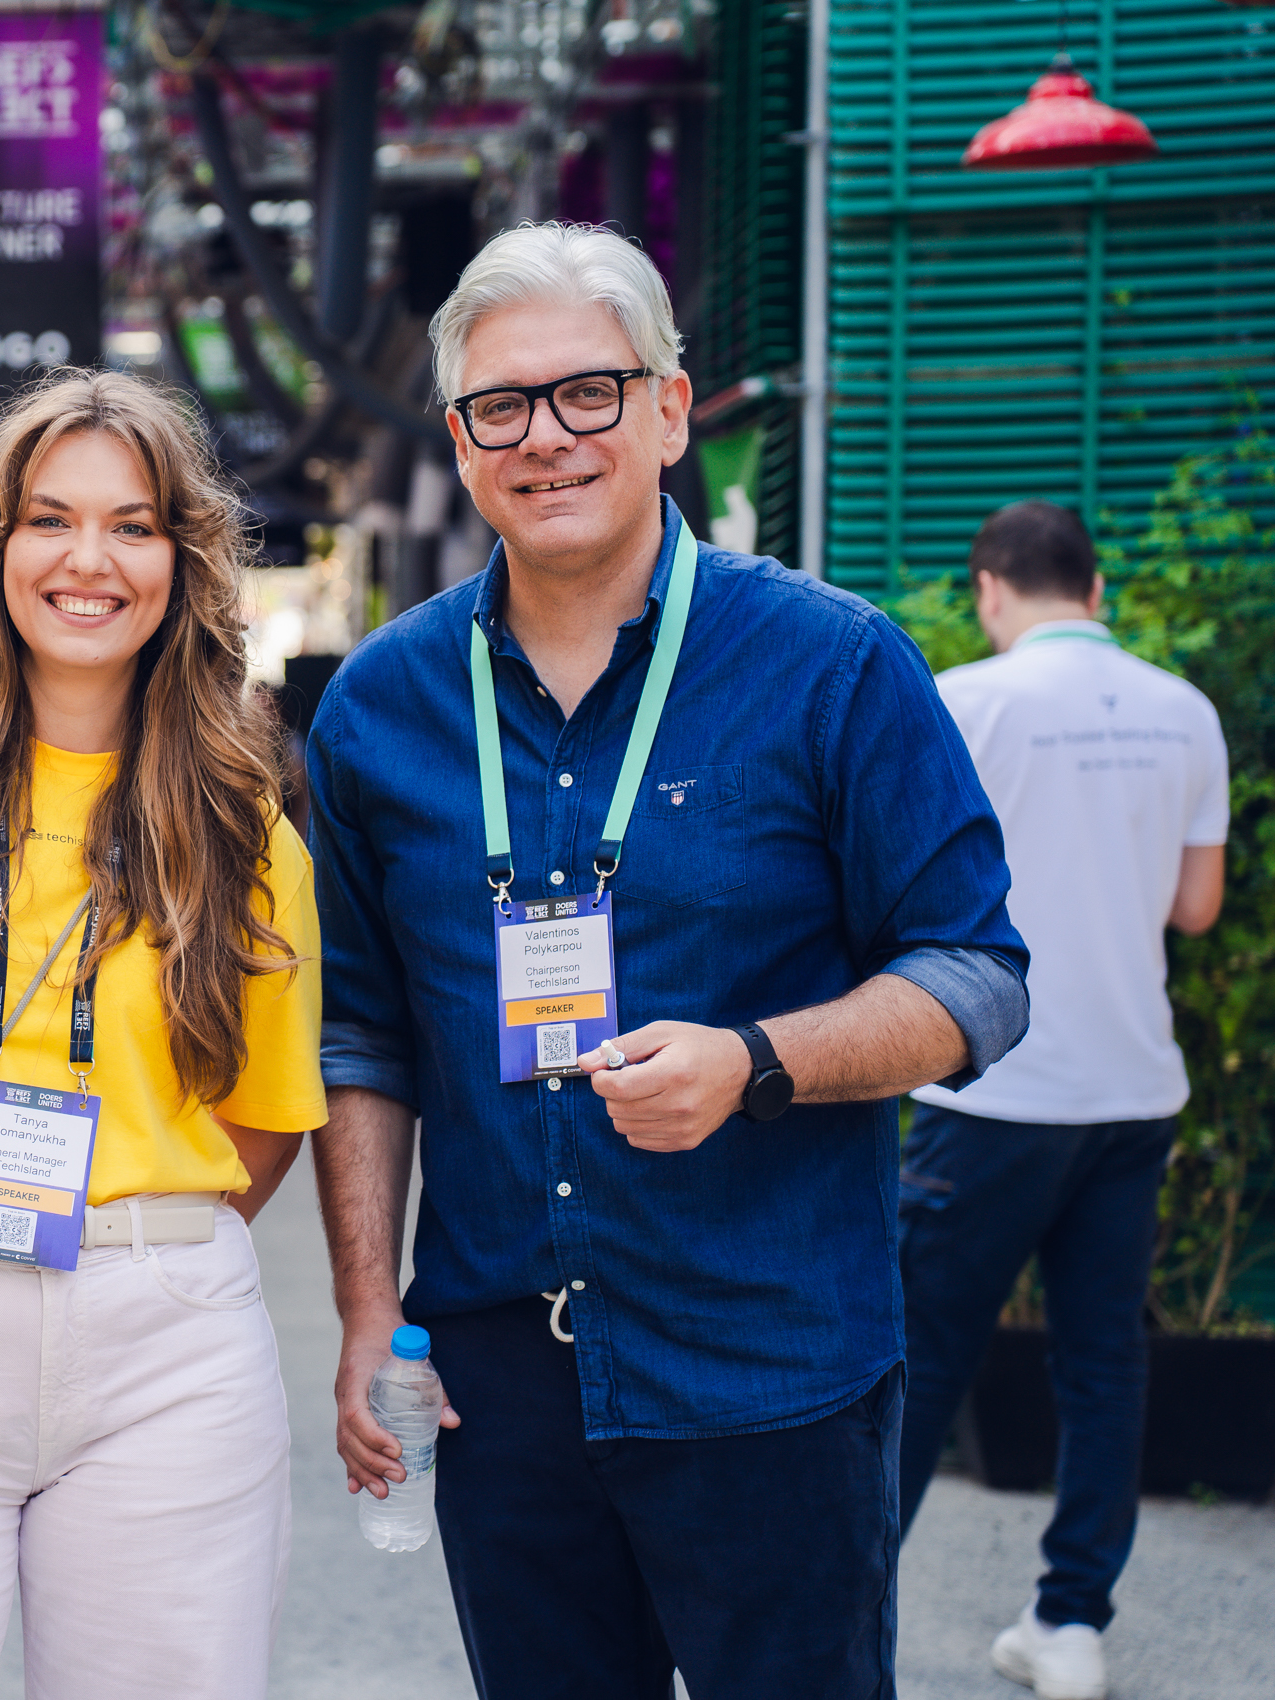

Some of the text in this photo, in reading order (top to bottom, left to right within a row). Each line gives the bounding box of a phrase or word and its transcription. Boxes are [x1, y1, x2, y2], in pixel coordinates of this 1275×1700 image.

[658, 779, 697, 791] GANT
[47, 832, 84, 847] techis
[555, 901, 578, 910] DOERS
[555, 907, 578, 916] UNITED
[525, 927, 580, 941] Valentinos
[524, 942, 582, 957] Polykarpou
[525, 964, 580, 976] Chairperson
[528, 975, 580, 989] TechIsland
[535, 1003, 575, 1016] SPEAKER
[37, 1099, 63, 1109] UNITED
[39, 1093, 63, 1103] DOERS
[14, 1113, 49, 1129] Tanya
[23, 1152, 67, 1168] Manager
